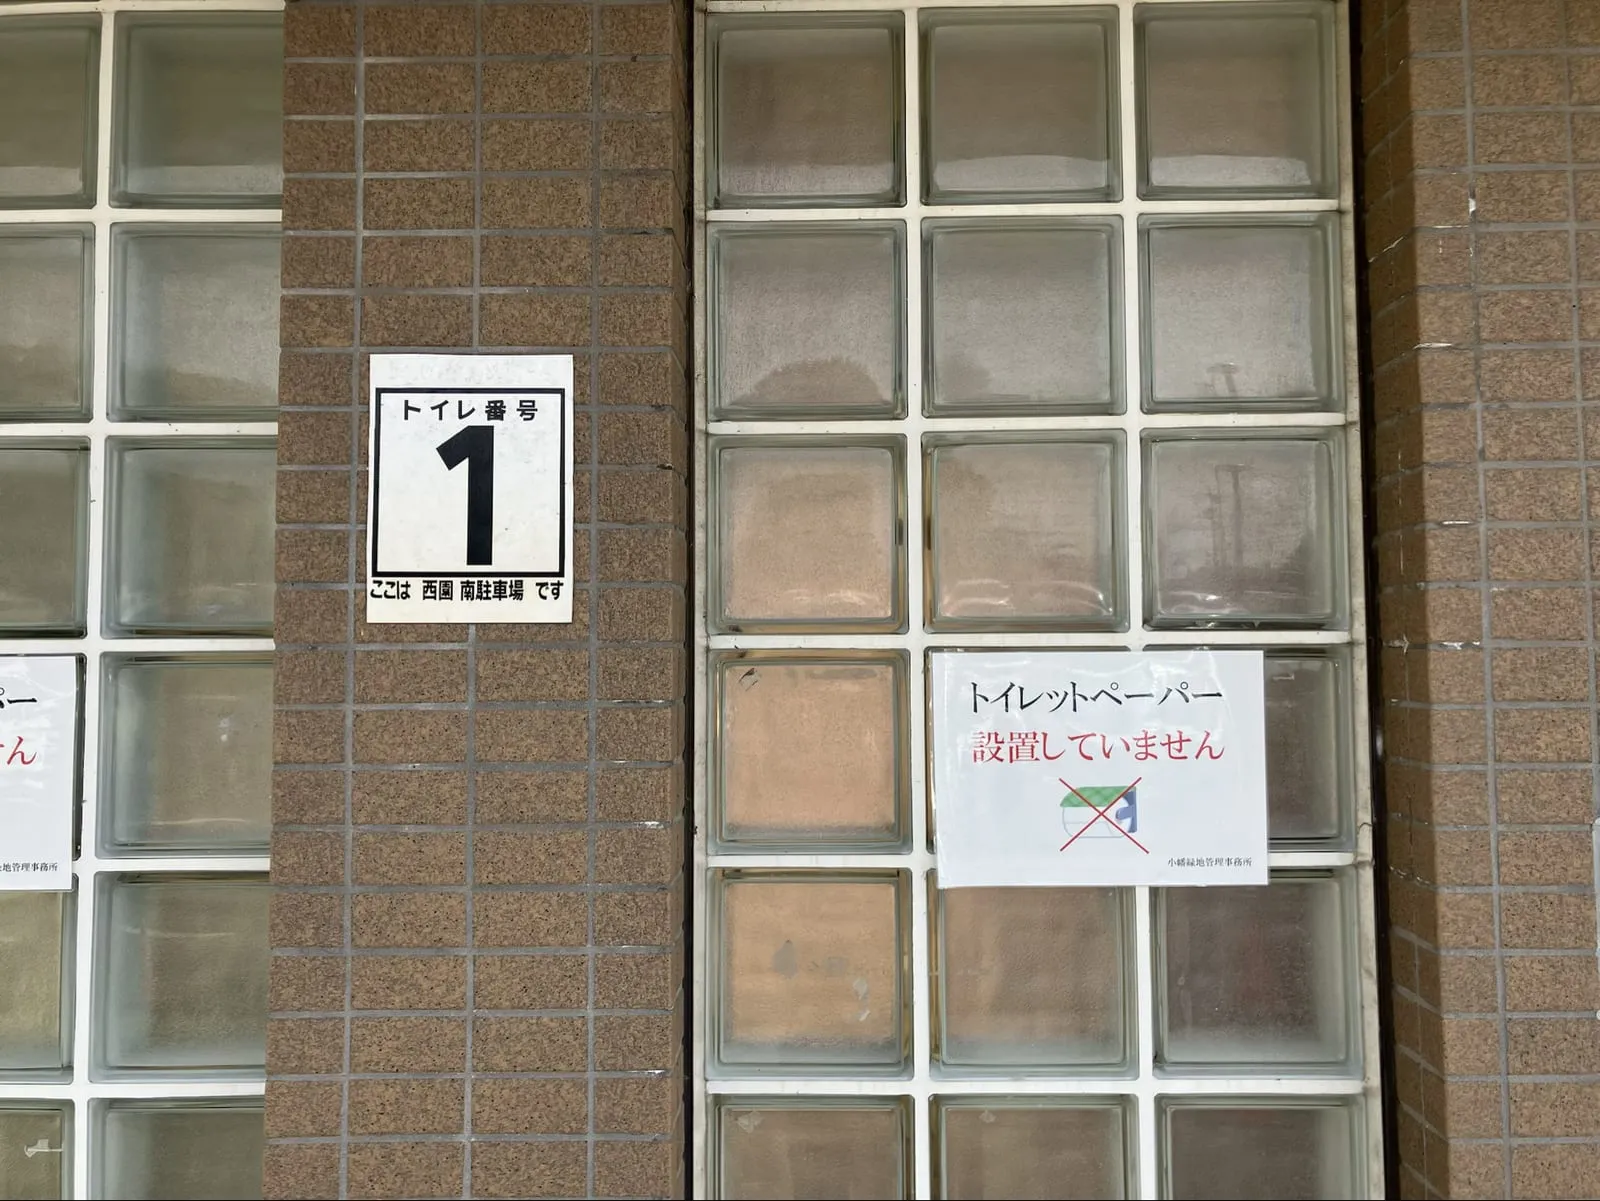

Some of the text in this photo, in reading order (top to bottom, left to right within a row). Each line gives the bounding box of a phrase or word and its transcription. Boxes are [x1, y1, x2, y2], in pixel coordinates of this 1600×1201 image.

[403, 399, 538, 421] トイレ番号
[436, 425, 494, 566] 1
[370, 579, 564, 601] ここは 西園 南駐車場 です
[0, 687, 38, 709] ー
[971, 681, 1223, 713] トイレットペーパー
[0, 735, 38, 765] ん
[972, 730, 1225, 764] 設置していません
[0, 862, 58, 872] 地管理事務所
